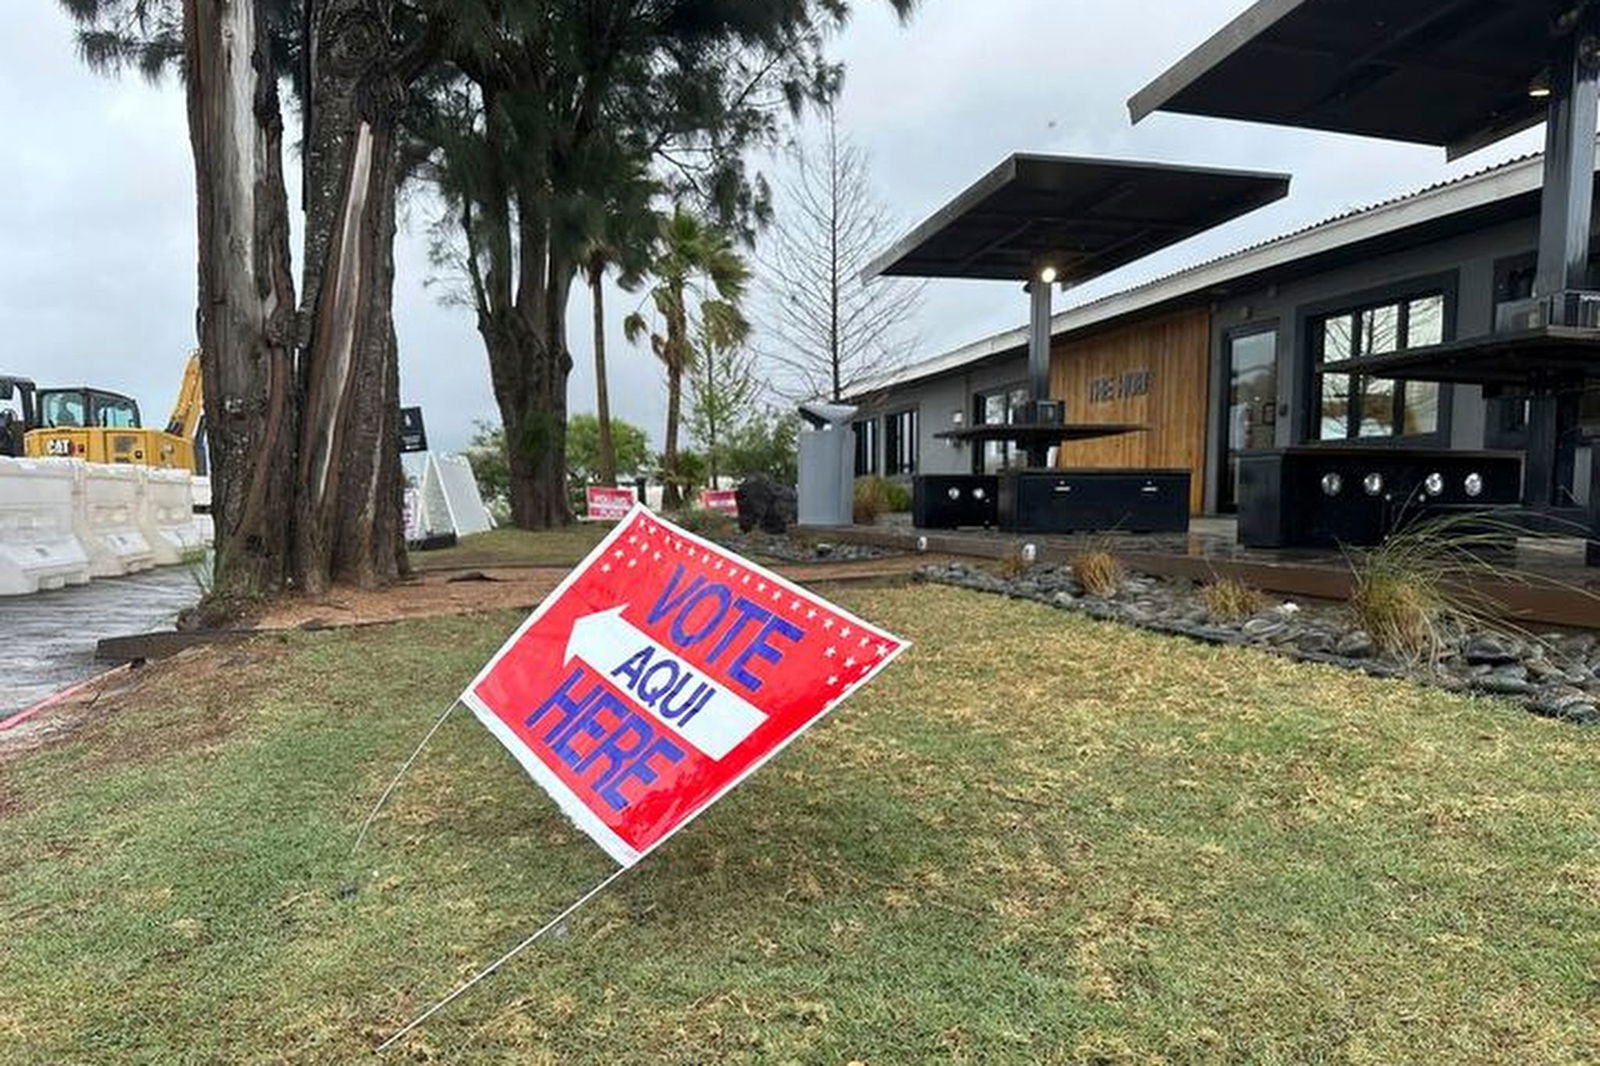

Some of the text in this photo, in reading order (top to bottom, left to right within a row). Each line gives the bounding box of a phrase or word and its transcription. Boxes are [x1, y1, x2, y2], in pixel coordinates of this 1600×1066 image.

[46, 439, 70, 455] CAT
[646, 563, 806, 692] VOTE
[525, 667, 686, 812] HERE
[610, 645, 717, 728] AQUI
